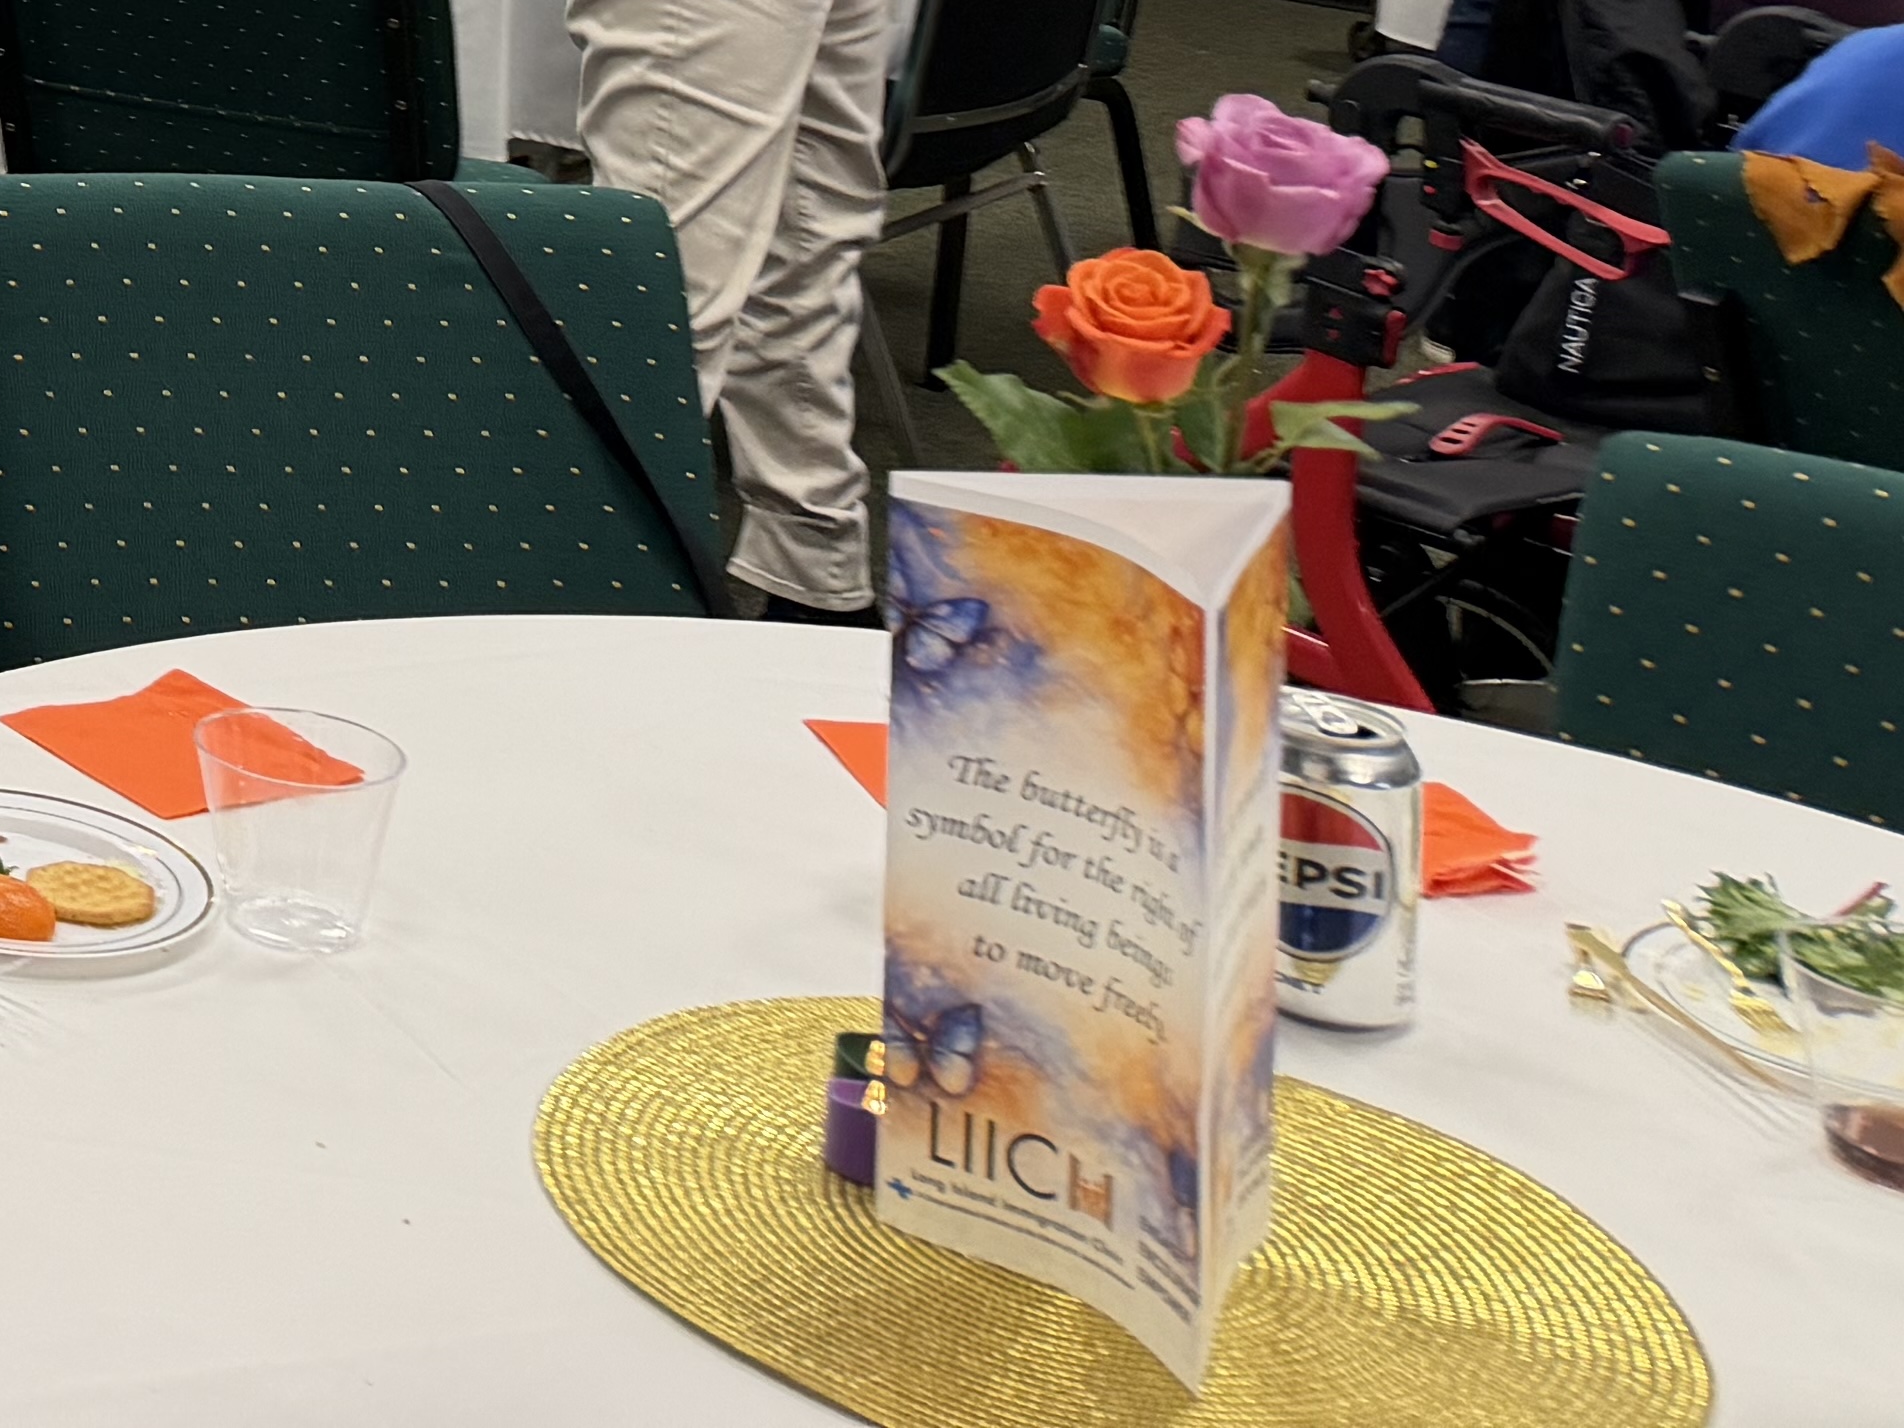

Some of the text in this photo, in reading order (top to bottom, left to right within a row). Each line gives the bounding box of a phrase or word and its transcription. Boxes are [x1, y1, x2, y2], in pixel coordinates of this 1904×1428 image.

[947, 754, 1011, 795] The
[1020, 770, 1142, 854] butterfly
[905, 807, 1204, 957] symbol for the right of
[1280, 850, 1383, 901] PSI
[957, 872, 1175, 990] all living beings
[972, 934, 1007, 964] to
[1015, 949, 1095, 997] move
